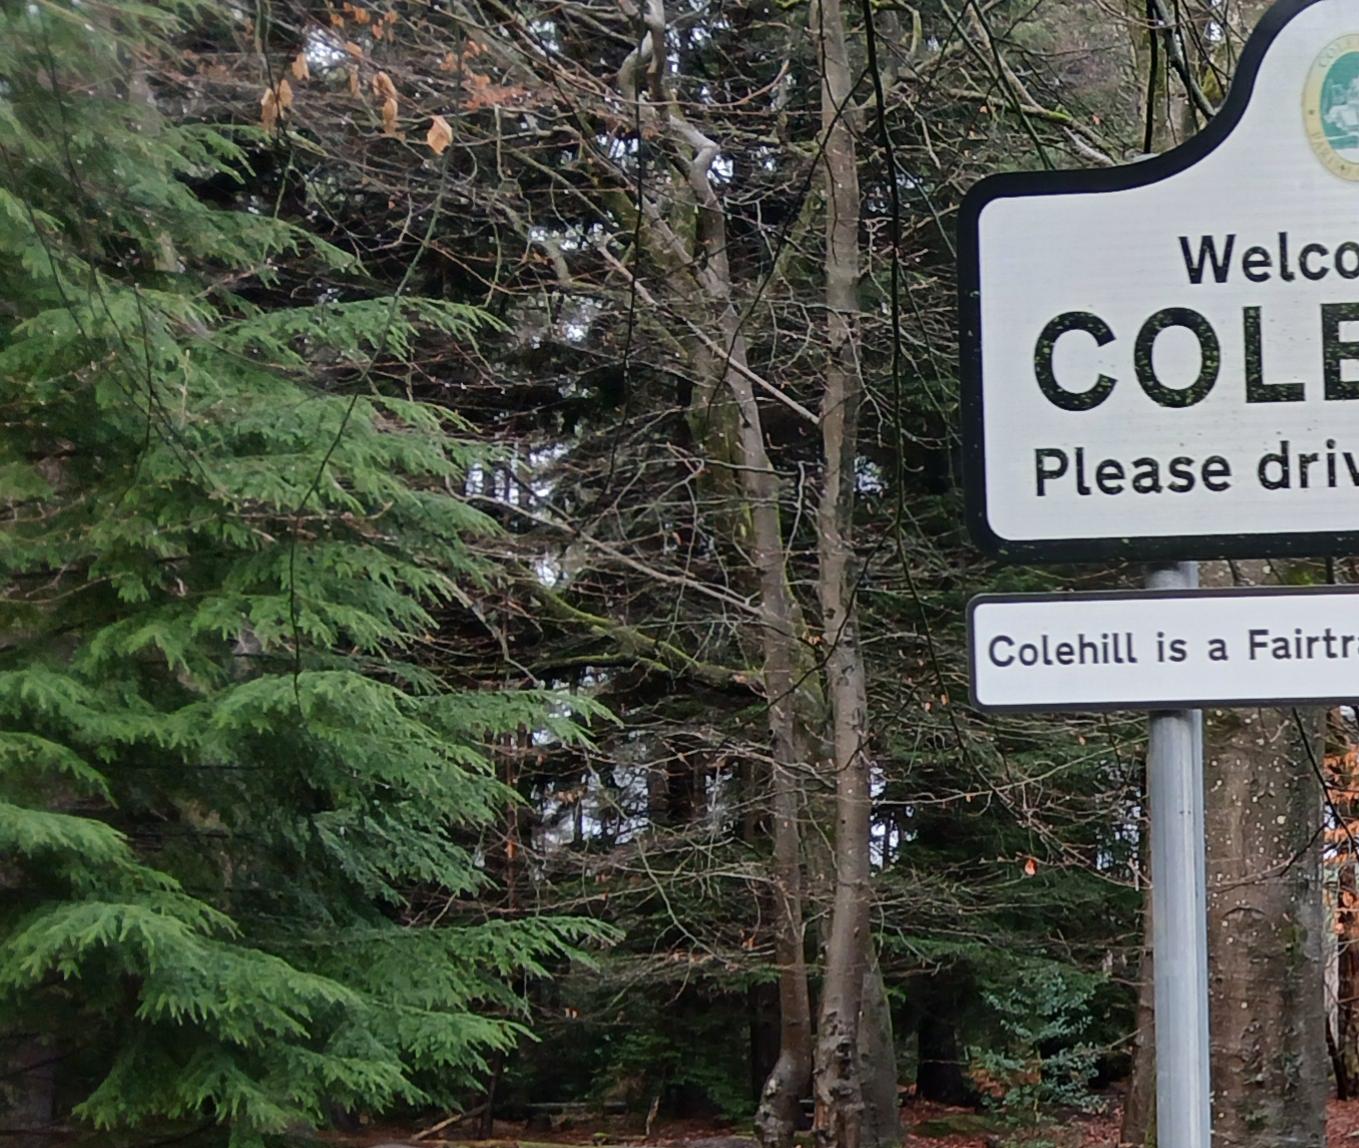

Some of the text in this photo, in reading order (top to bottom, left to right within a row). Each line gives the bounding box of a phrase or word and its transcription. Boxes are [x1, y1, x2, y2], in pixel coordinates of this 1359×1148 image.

[1034, 446, 1232, 497] Please
[988, 632, 1138, 668] Colehill
[1157, 631, 1187, 663] is
[1208, 638, 1229, 662] a
